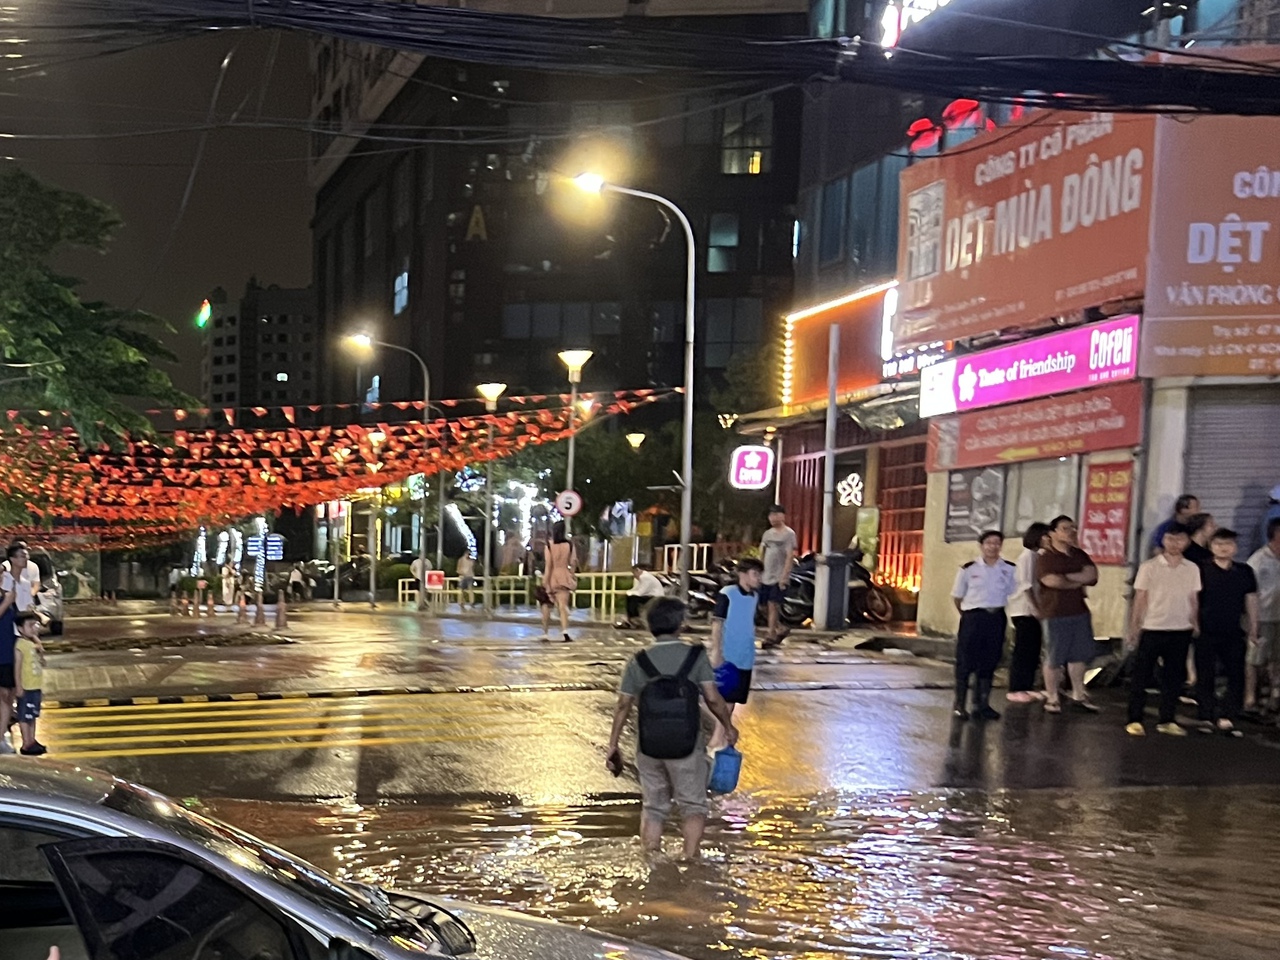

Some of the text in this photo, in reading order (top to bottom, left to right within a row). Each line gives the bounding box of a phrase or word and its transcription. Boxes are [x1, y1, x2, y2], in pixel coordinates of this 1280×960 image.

[1019, 141, 1038, 169] TY
[944, 200, 993, 280] DỆT
[992, 178, 1053, 257] MÙA
[1186, 212, 1271, 273] DỆT
[1006, 360, 1019, 382] of
[1019, 350, 1076, 379] friendship
